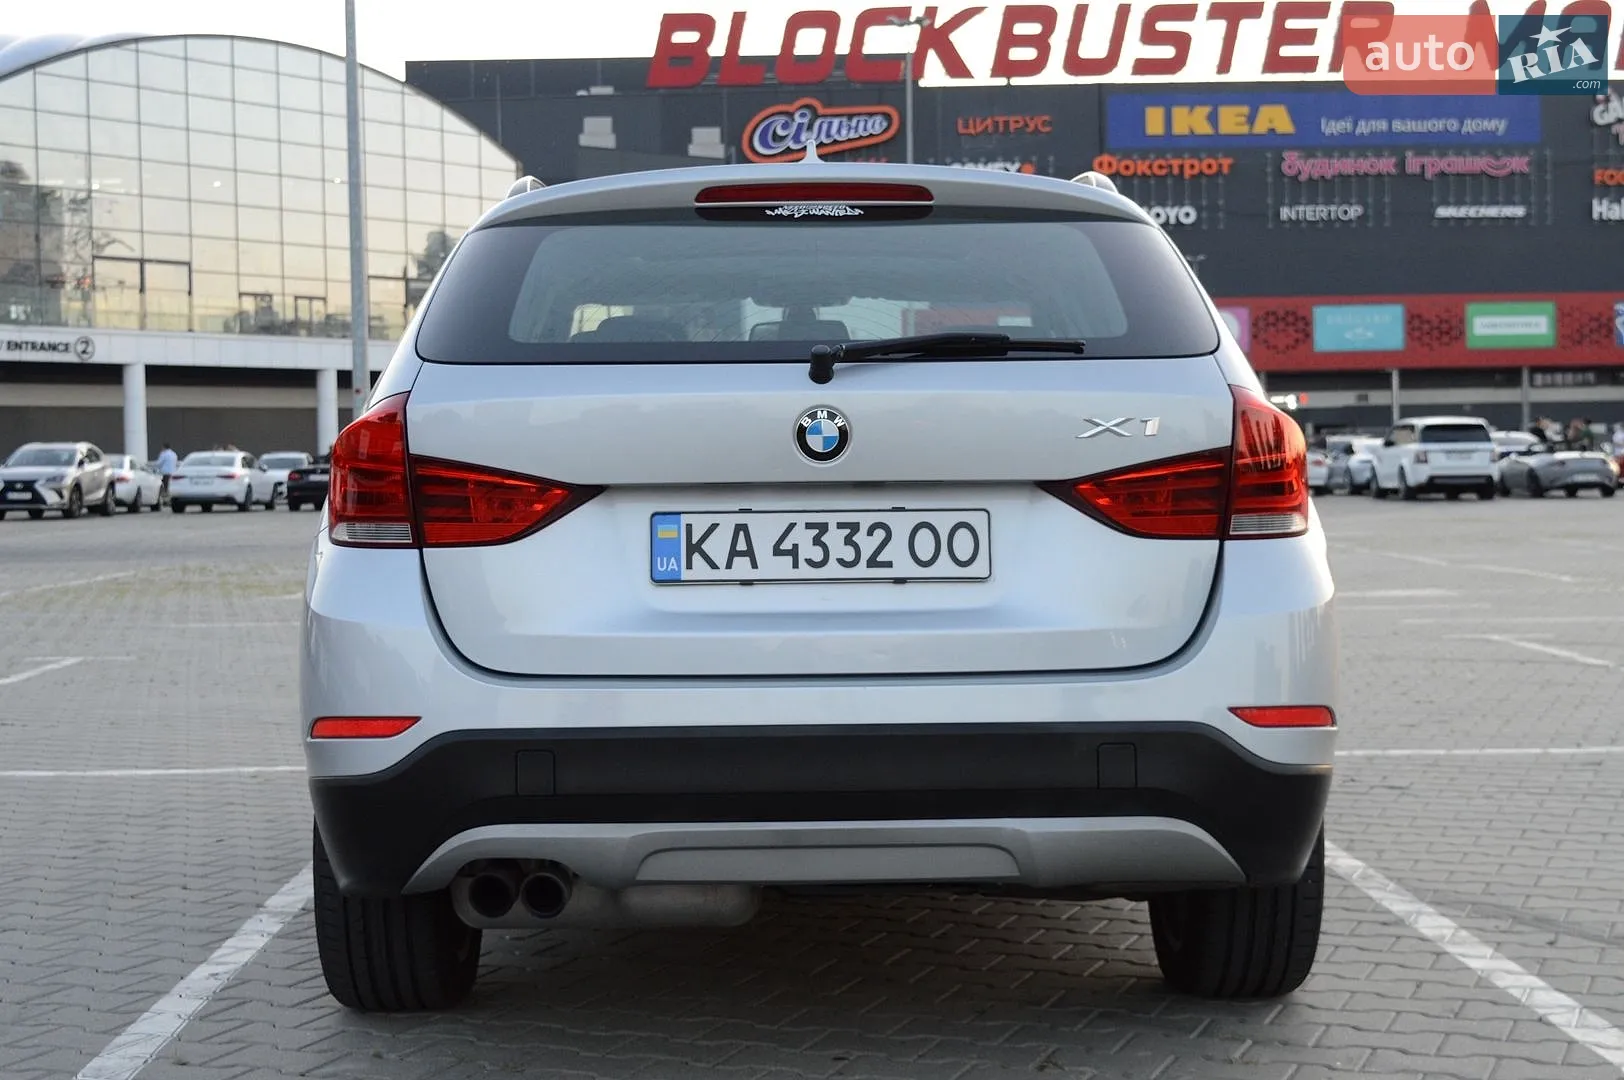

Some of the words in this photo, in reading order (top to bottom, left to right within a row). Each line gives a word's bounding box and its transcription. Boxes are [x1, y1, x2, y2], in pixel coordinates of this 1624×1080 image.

[645, 1, 1395, 88] BLOCKBUSTER
[955, 114, 1053, 136] ЦИТРУС
[1144, 104, 1296, 136] IKEA
[1355, 118, 1388, 136] для
[1391, 119, 1459, 134] вашого
[1461, 117, 1508, 136] дому
[1092, 153, 1234, 179] Фокстрот
[1146, 205, 1197, 224] OYO
[1279, 204, 1364, 222] INTERTOP
[7, 340, 72, 353] ENTRANCE
[801, 411, 845, 427] BMW
[1076, 416, 1160, 438] X1
[685, 522, 759, 570] KA
[772, 521, 894, 569] 4332
[656, 556, 679, 572] UA
